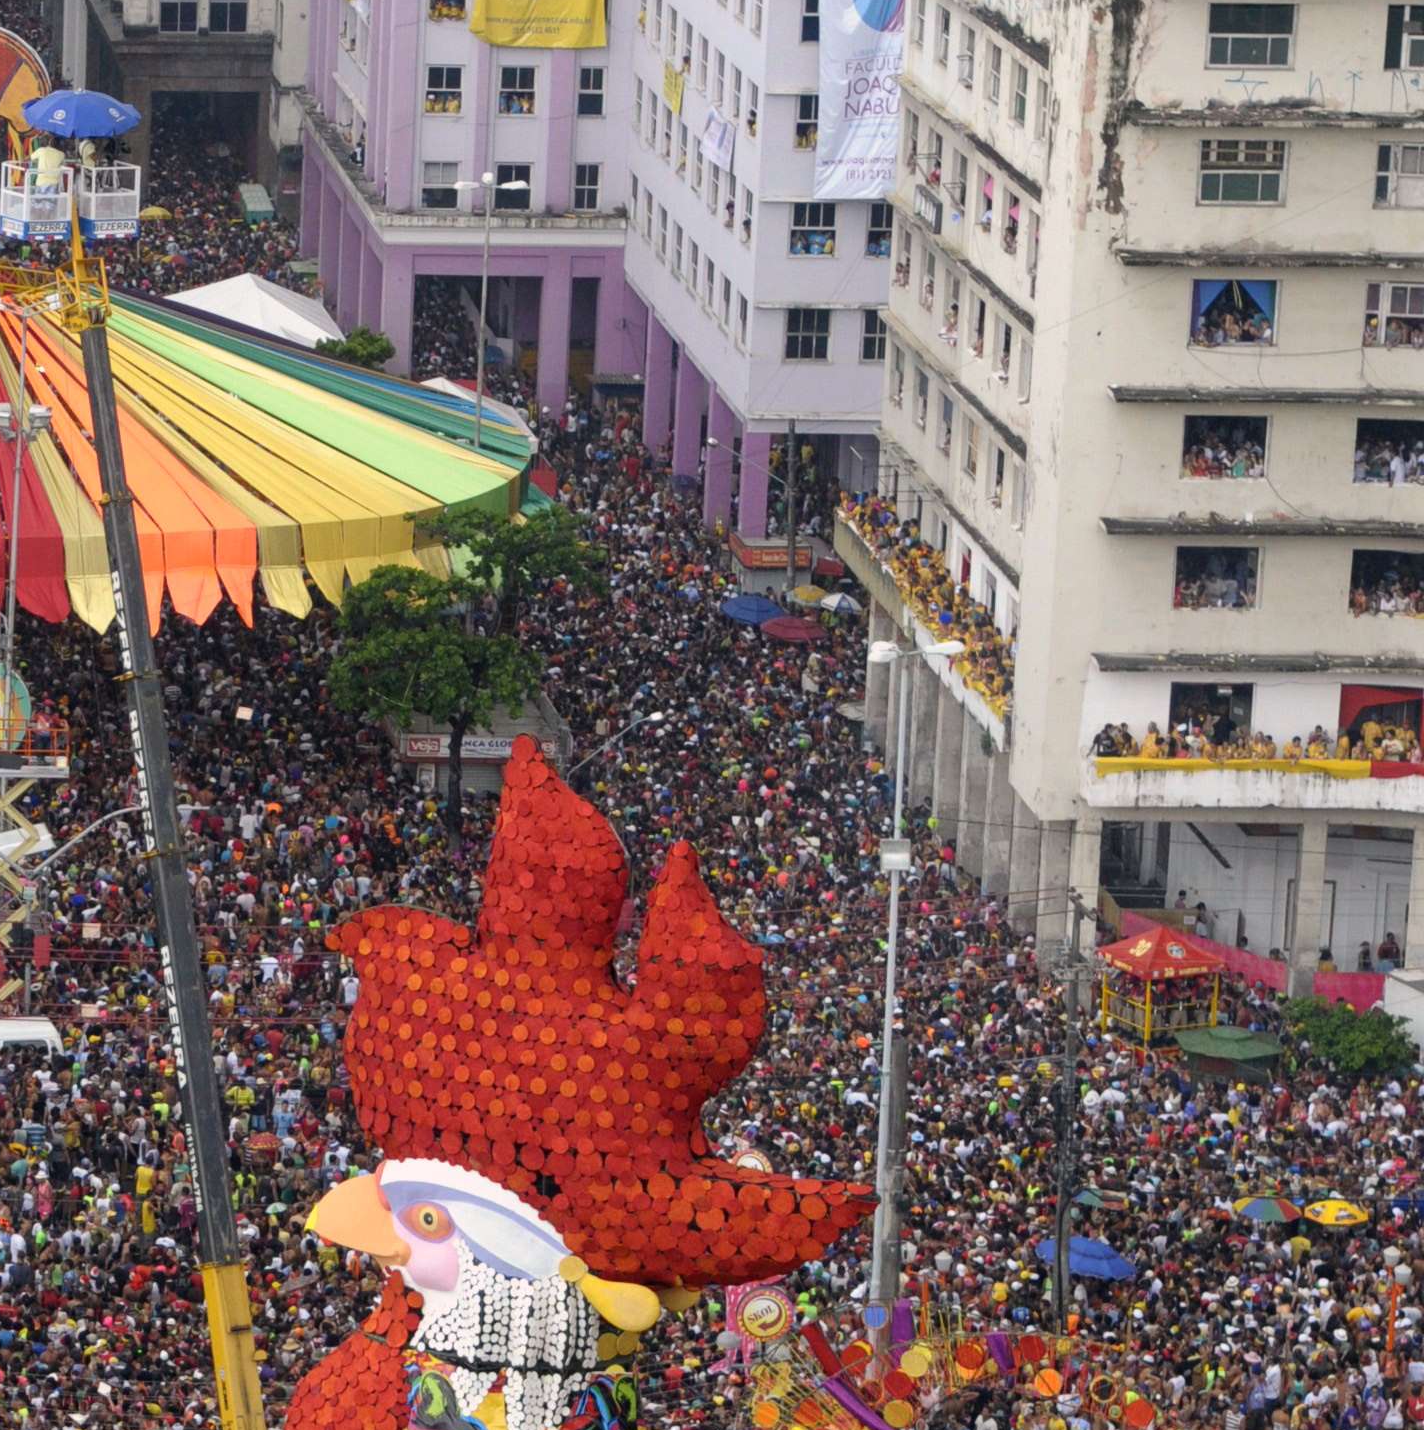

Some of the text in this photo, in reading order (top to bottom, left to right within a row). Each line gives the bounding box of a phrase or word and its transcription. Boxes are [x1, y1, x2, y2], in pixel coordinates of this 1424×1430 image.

[128, 709, 156, 852] BEZERRA
[160, 945, 187, 1089] BEZERRA
[747, 1306, 776, 1324] SKOL
